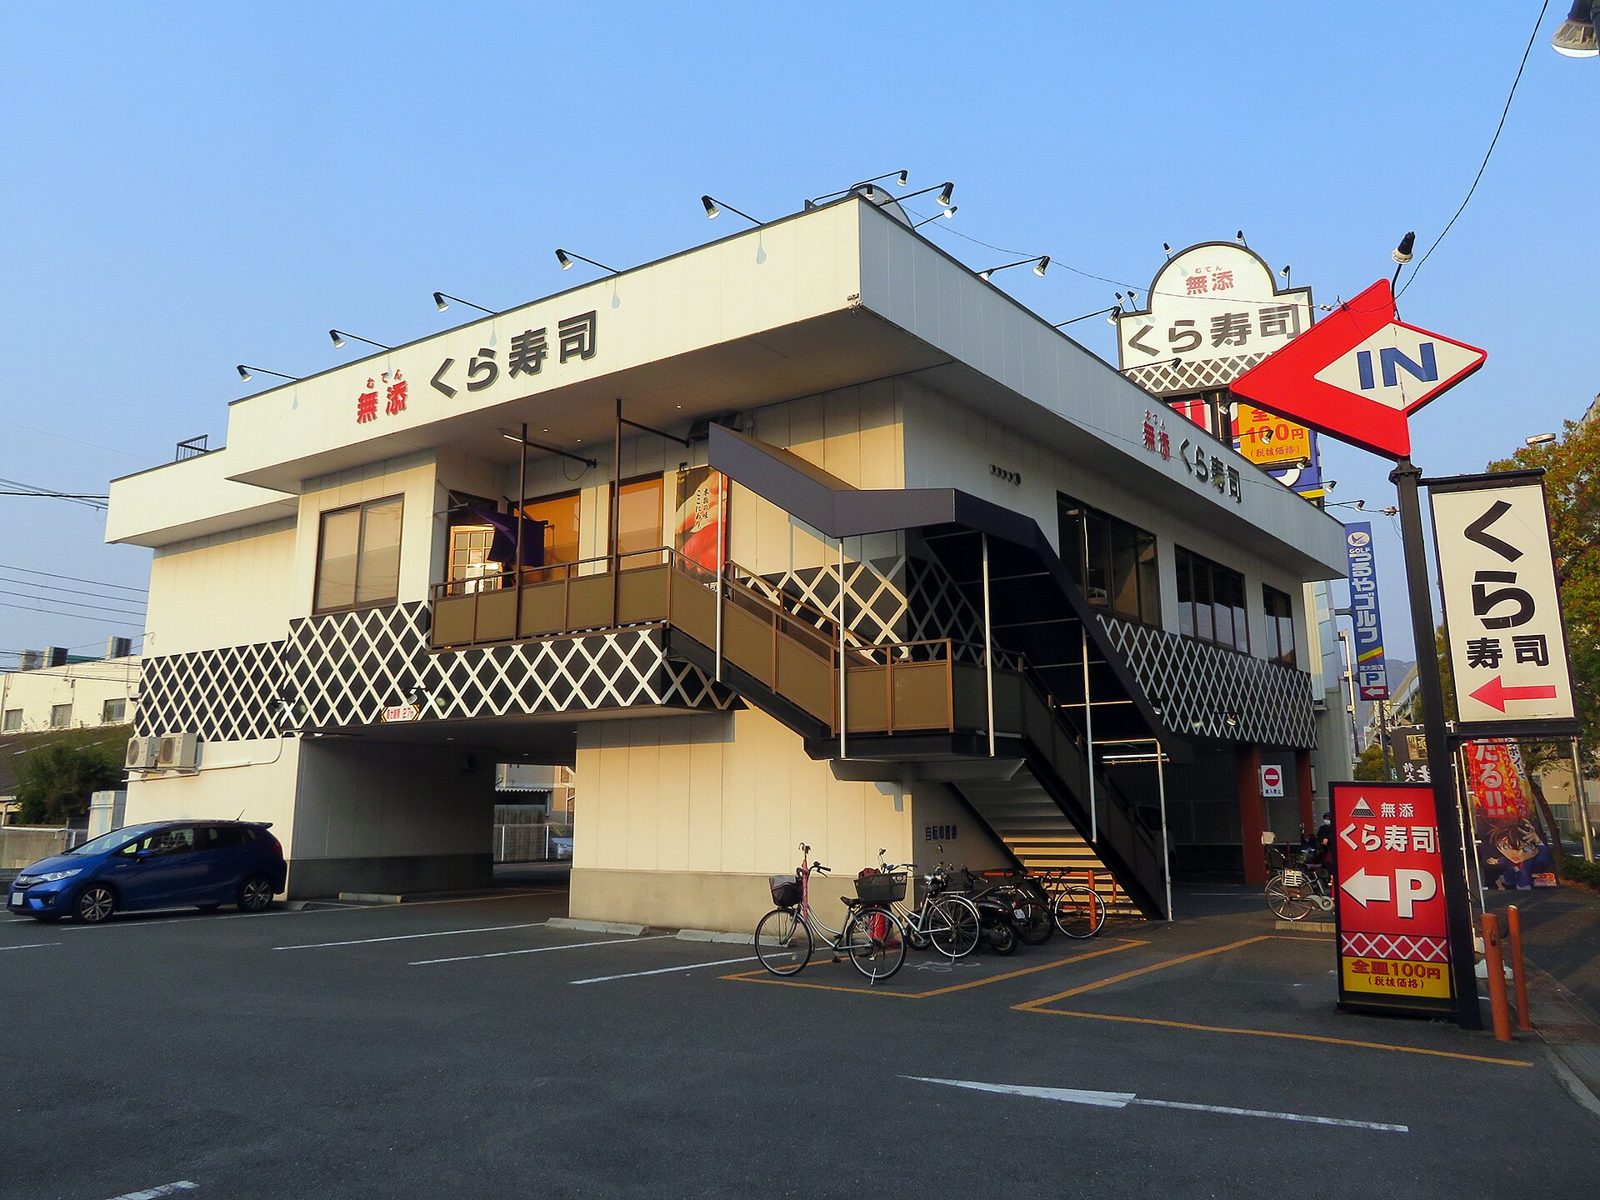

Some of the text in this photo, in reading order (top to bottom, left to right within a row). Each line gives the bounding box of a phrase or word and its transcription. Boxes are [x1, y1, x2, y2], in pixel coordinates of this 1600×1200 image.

[1195, 265, 1223, 274] むてん
[1186, 270, 1235, 296] 無添
[1128, 304, 1301, 357] くら寿司
[357, 309, 598, 424] 無添 くら寿司
[366, 369, 404, 388] むてん
[1356, 342, 1438, 390] IN
[1246, 423, 1304, 444] 100円
[1142, 420, 1242, 504] 無添 くら寿司
[1349, 552, 1379, 643] つるやゴルフ
[1366, 673, 1380, 685] P
[1380, 802, 1414, 818] 無添
[1339, 822, 1440, 853] くら寿司
[1395, 868, 1437, 918] P
[1351, 958, 1441, 980] 全皿100円
[1368, 976, 1425, 989] (税抜価格)
